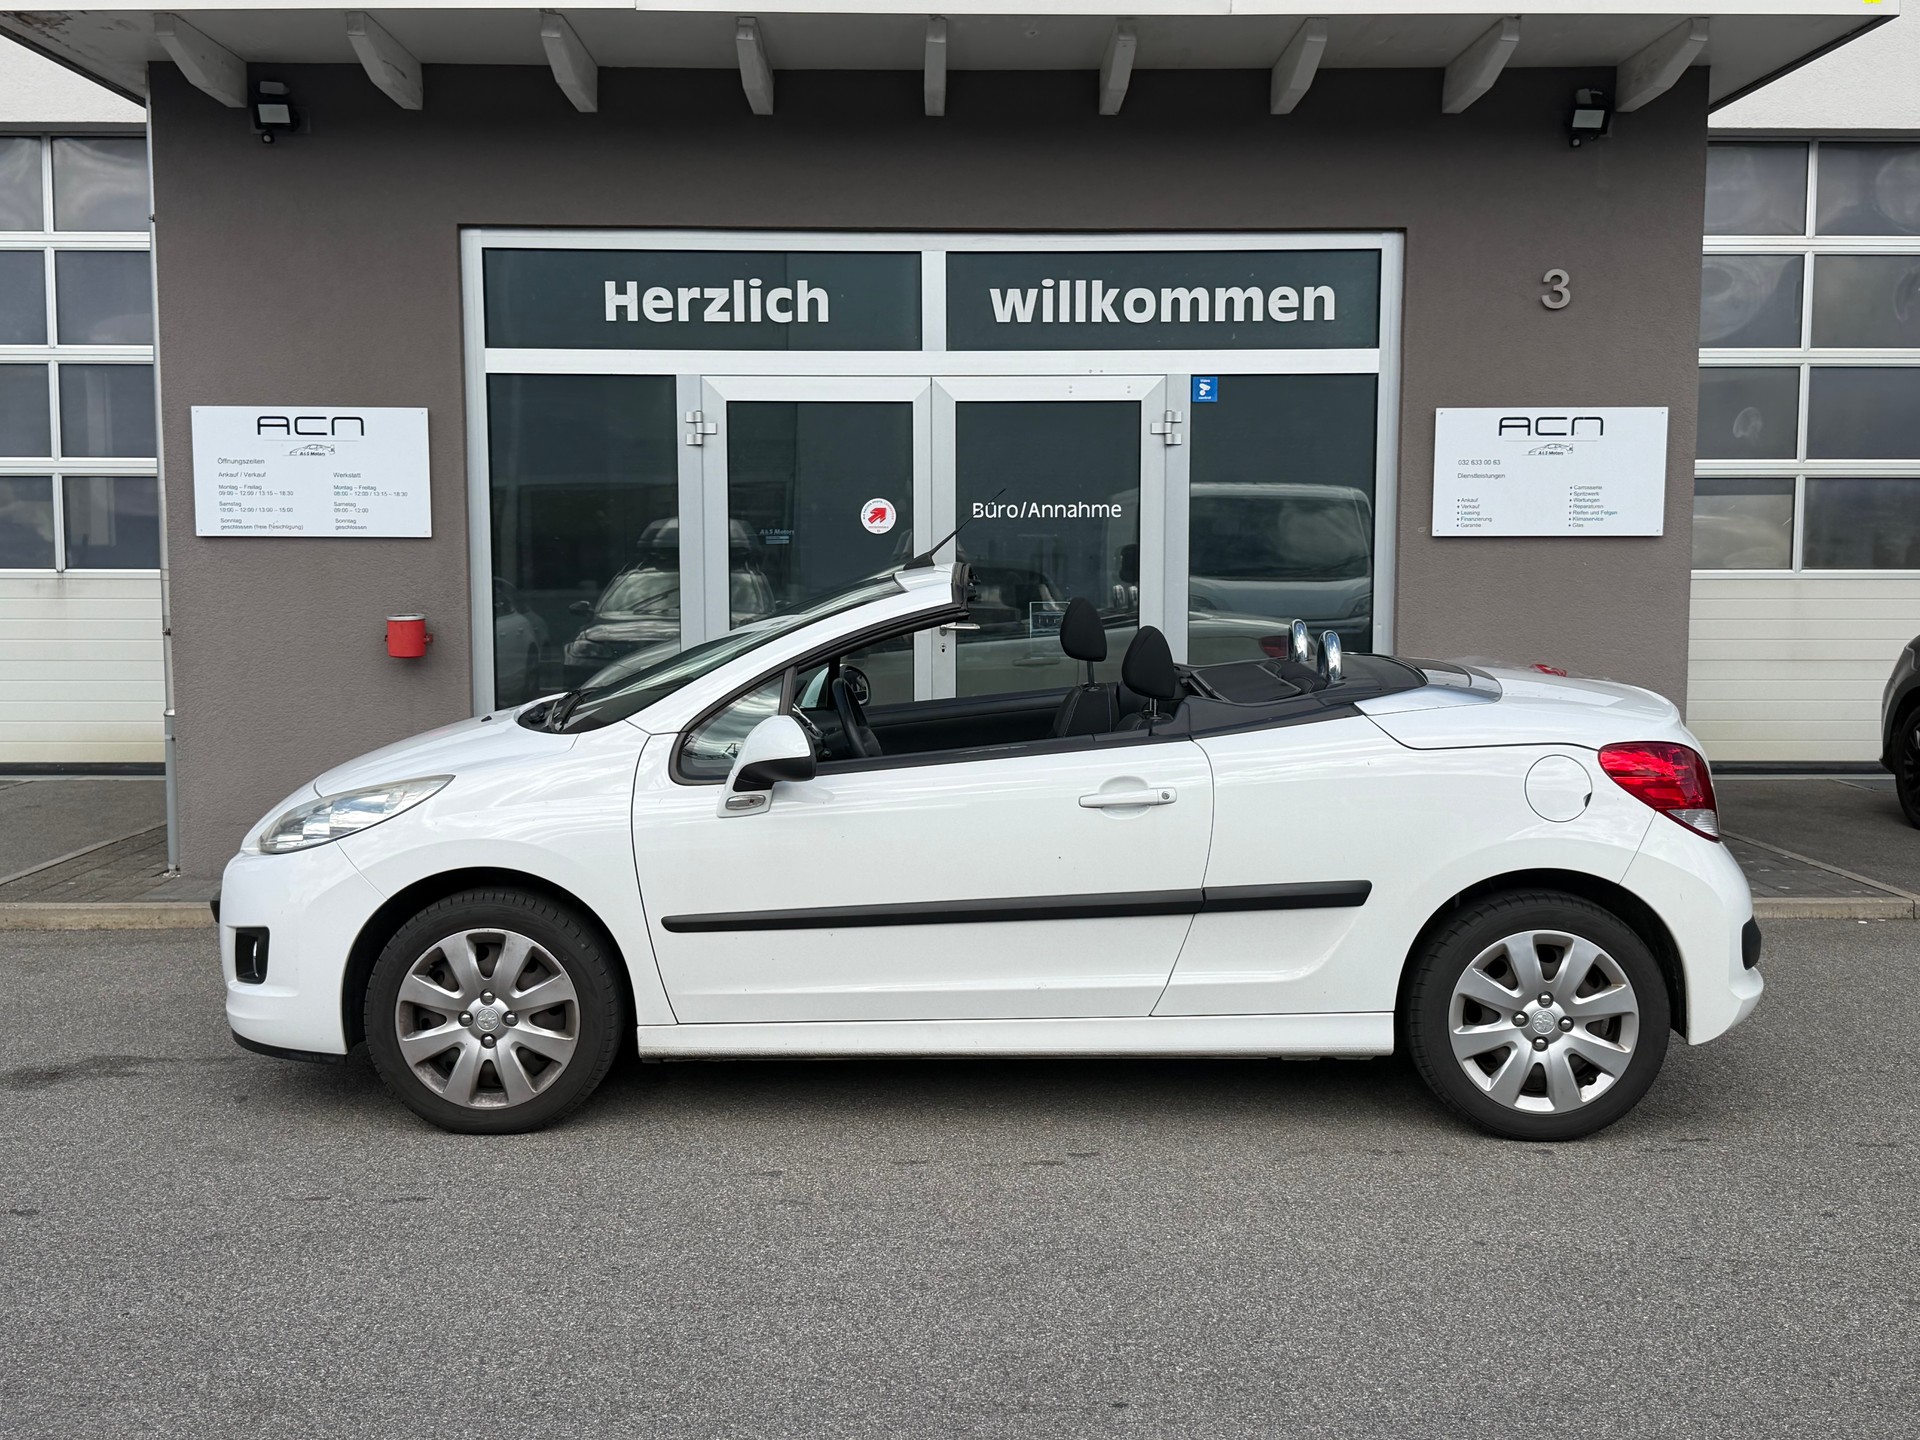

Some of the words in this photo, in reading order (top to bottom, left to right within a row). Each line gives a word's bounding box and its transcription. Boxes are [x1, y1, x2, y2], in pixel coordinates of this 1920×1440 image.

[1540, 268, 1571, 310] 3
[604, 278, 829, 323] Herzlich
[989, 279, 1336, 324] willkommen
[257, 416, 365, 436] ACN
[1498, 416, 1604, 436] ACN
[217, 457, 265, 466] Öffnungszeiten
[972, 500, 1122, 519] Büro/Annahme
